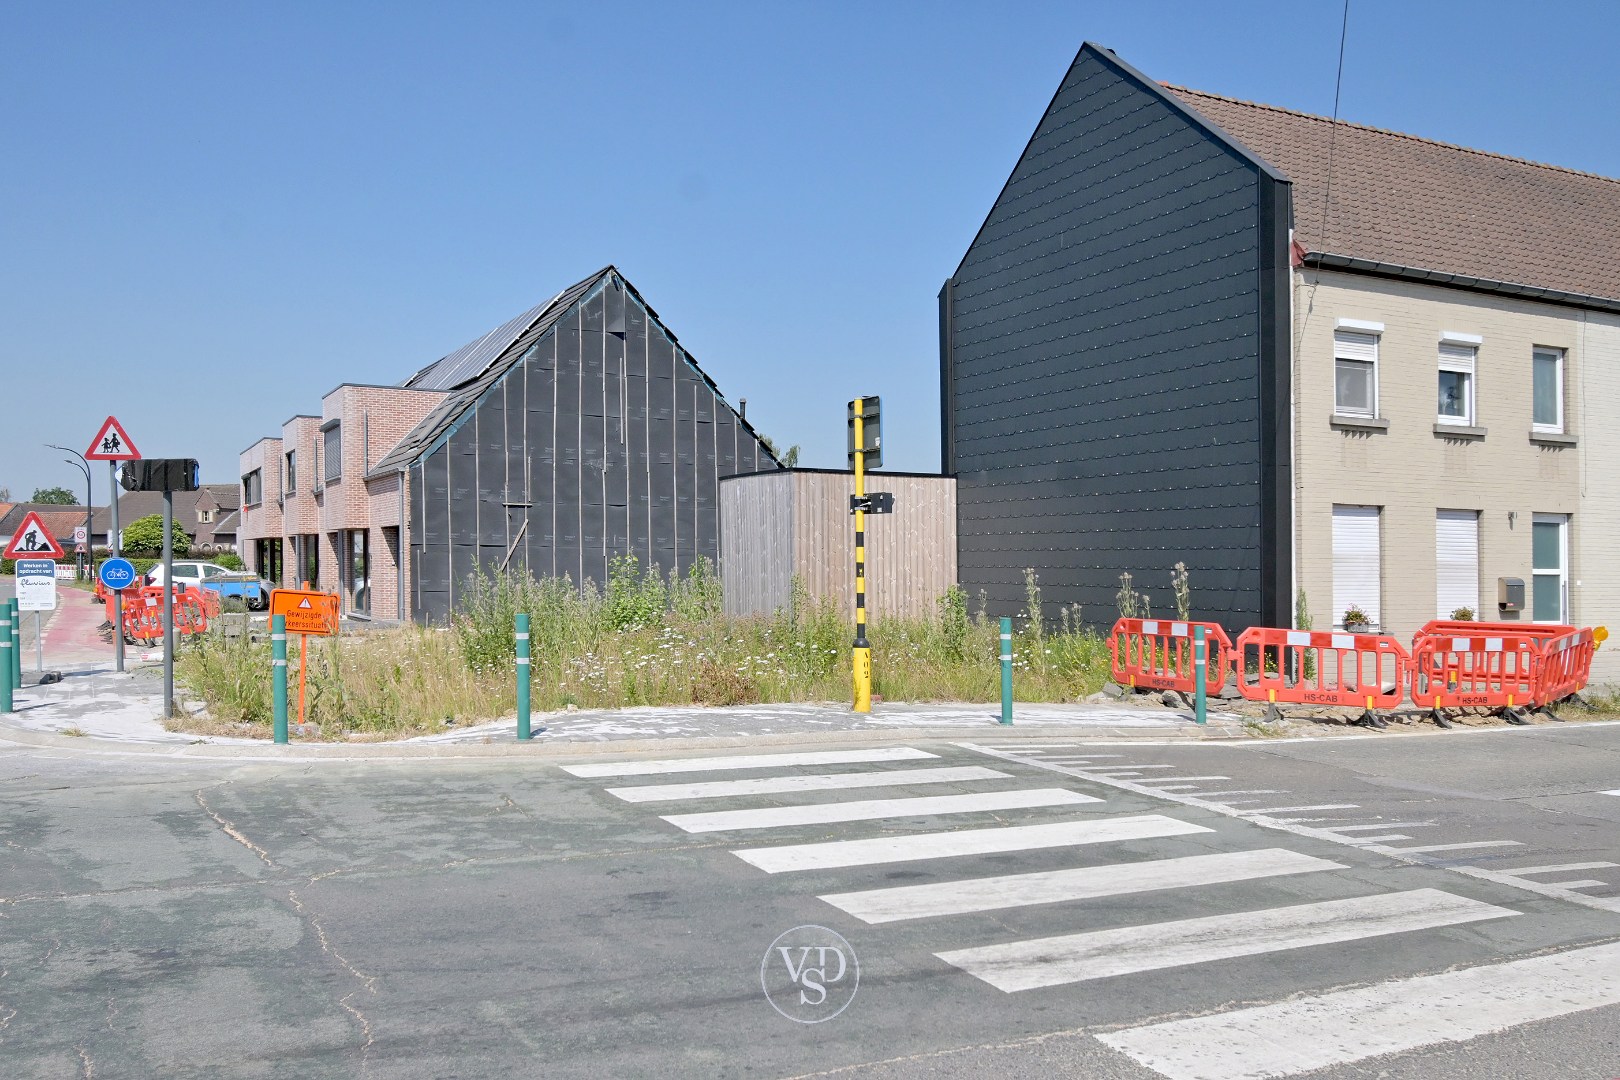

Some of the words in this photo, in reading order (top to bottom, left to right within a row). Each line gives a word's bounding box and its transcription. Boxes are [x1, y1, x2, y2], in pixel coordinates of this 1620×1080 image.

[286, 609, 322, 621] Gewijzigde
[1152, 679, 1175, 688] HS-CAB
[1304, 693, 1338, 703] HS-CAB
[1462, 696, 1488, 705] HS-CAB
